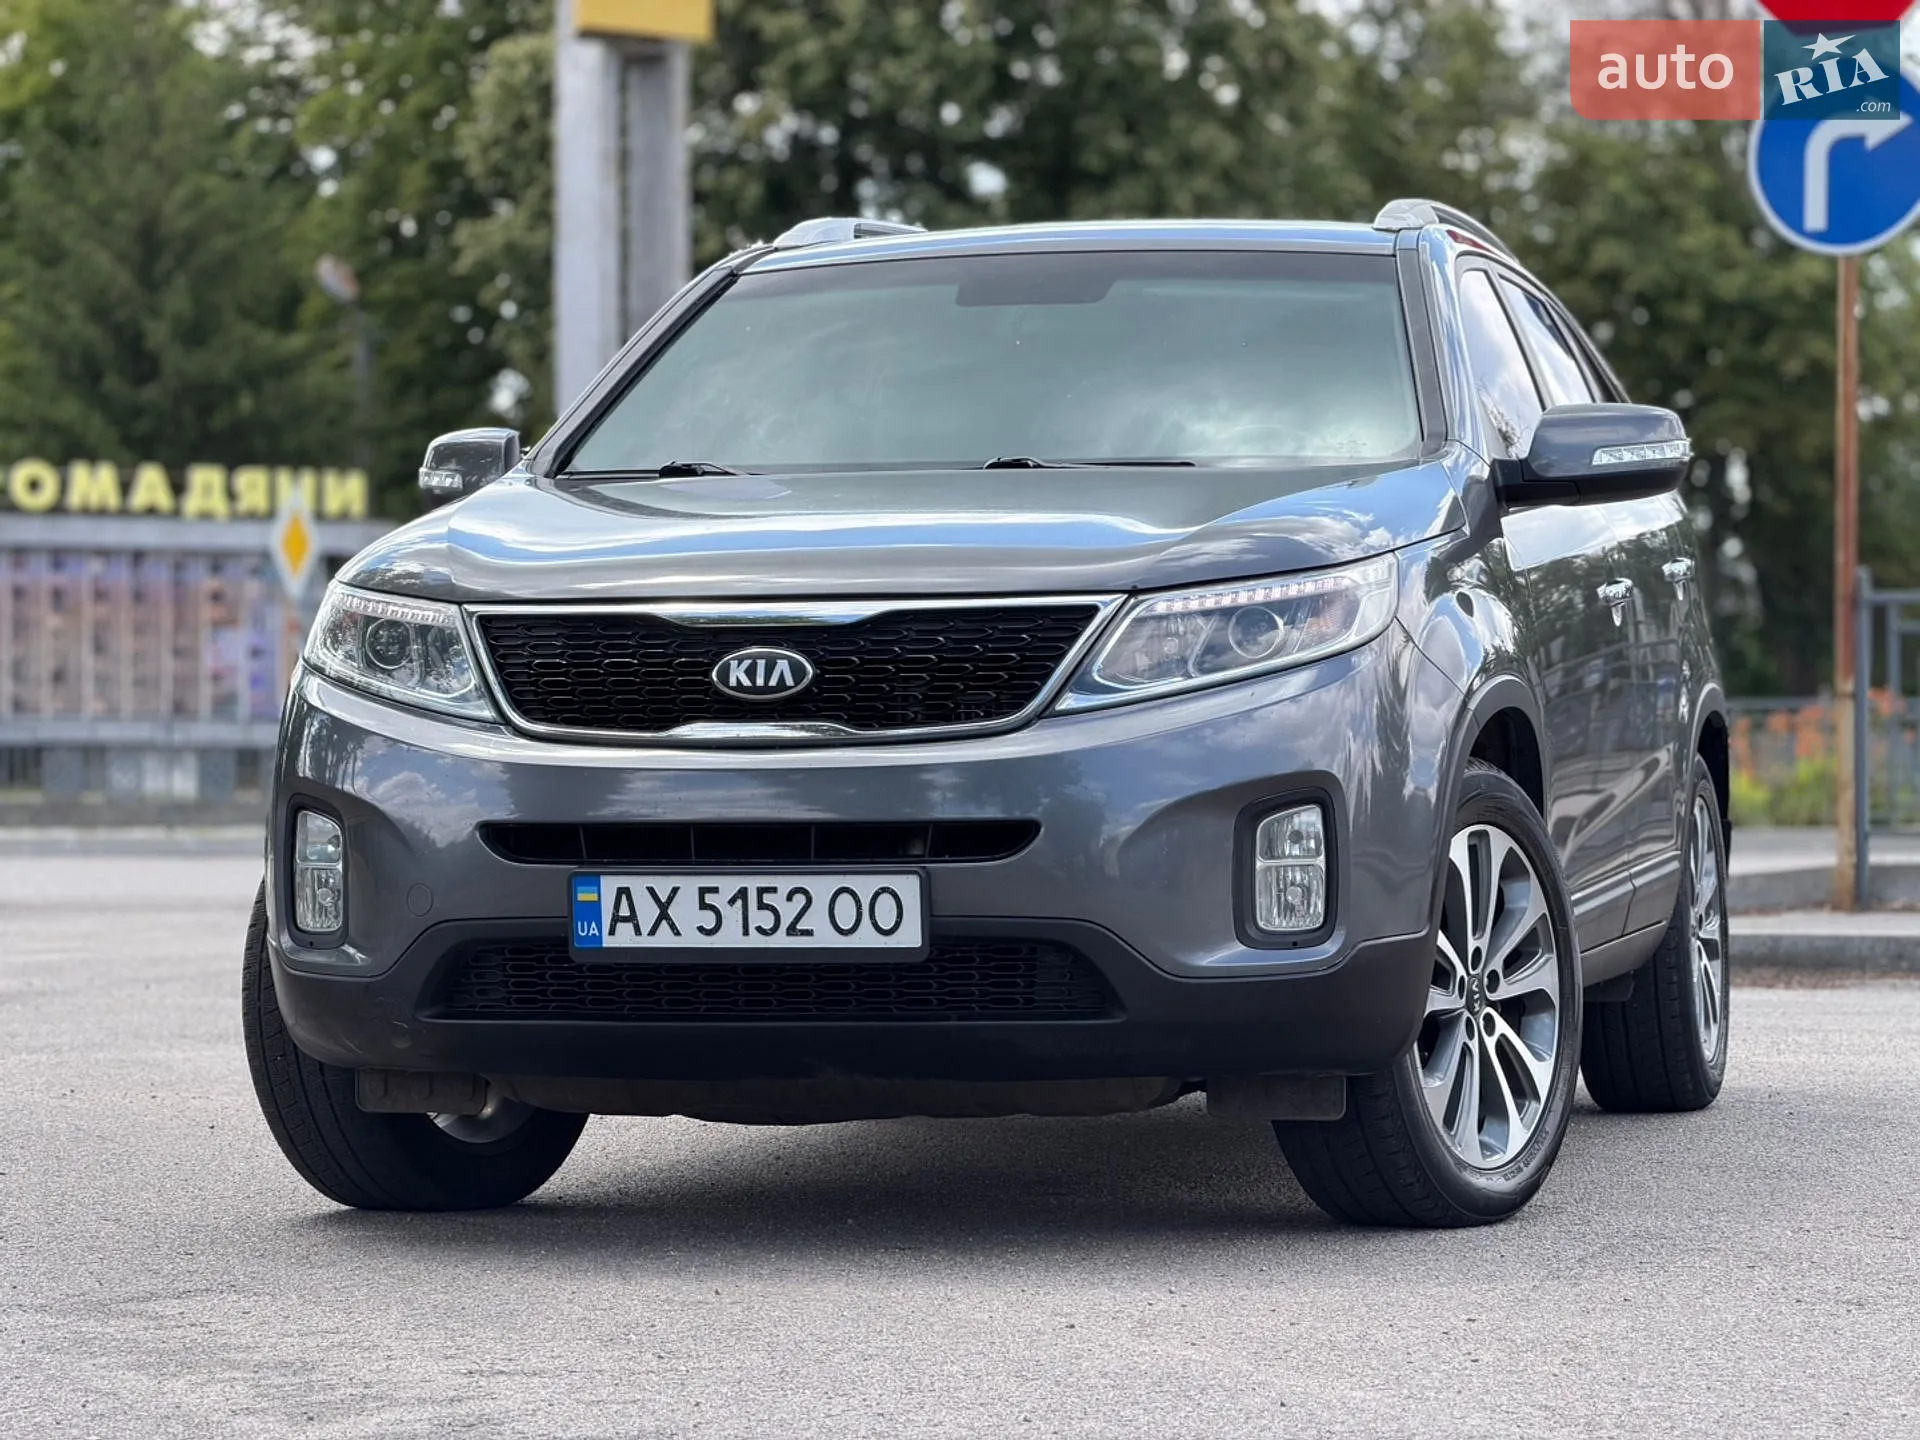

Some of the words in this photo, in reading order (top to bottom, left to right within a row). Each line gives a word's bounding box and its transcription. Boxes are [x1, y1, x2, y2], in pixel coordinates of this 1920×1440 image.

[0, 457, 368, 520] ОМАДЯНИ
[728, 659, 795, 687] KIA
[577, 920, 600, 936] UA
[607, 886, 682, 936] AX
[696, 886, 815, 936] 5152
